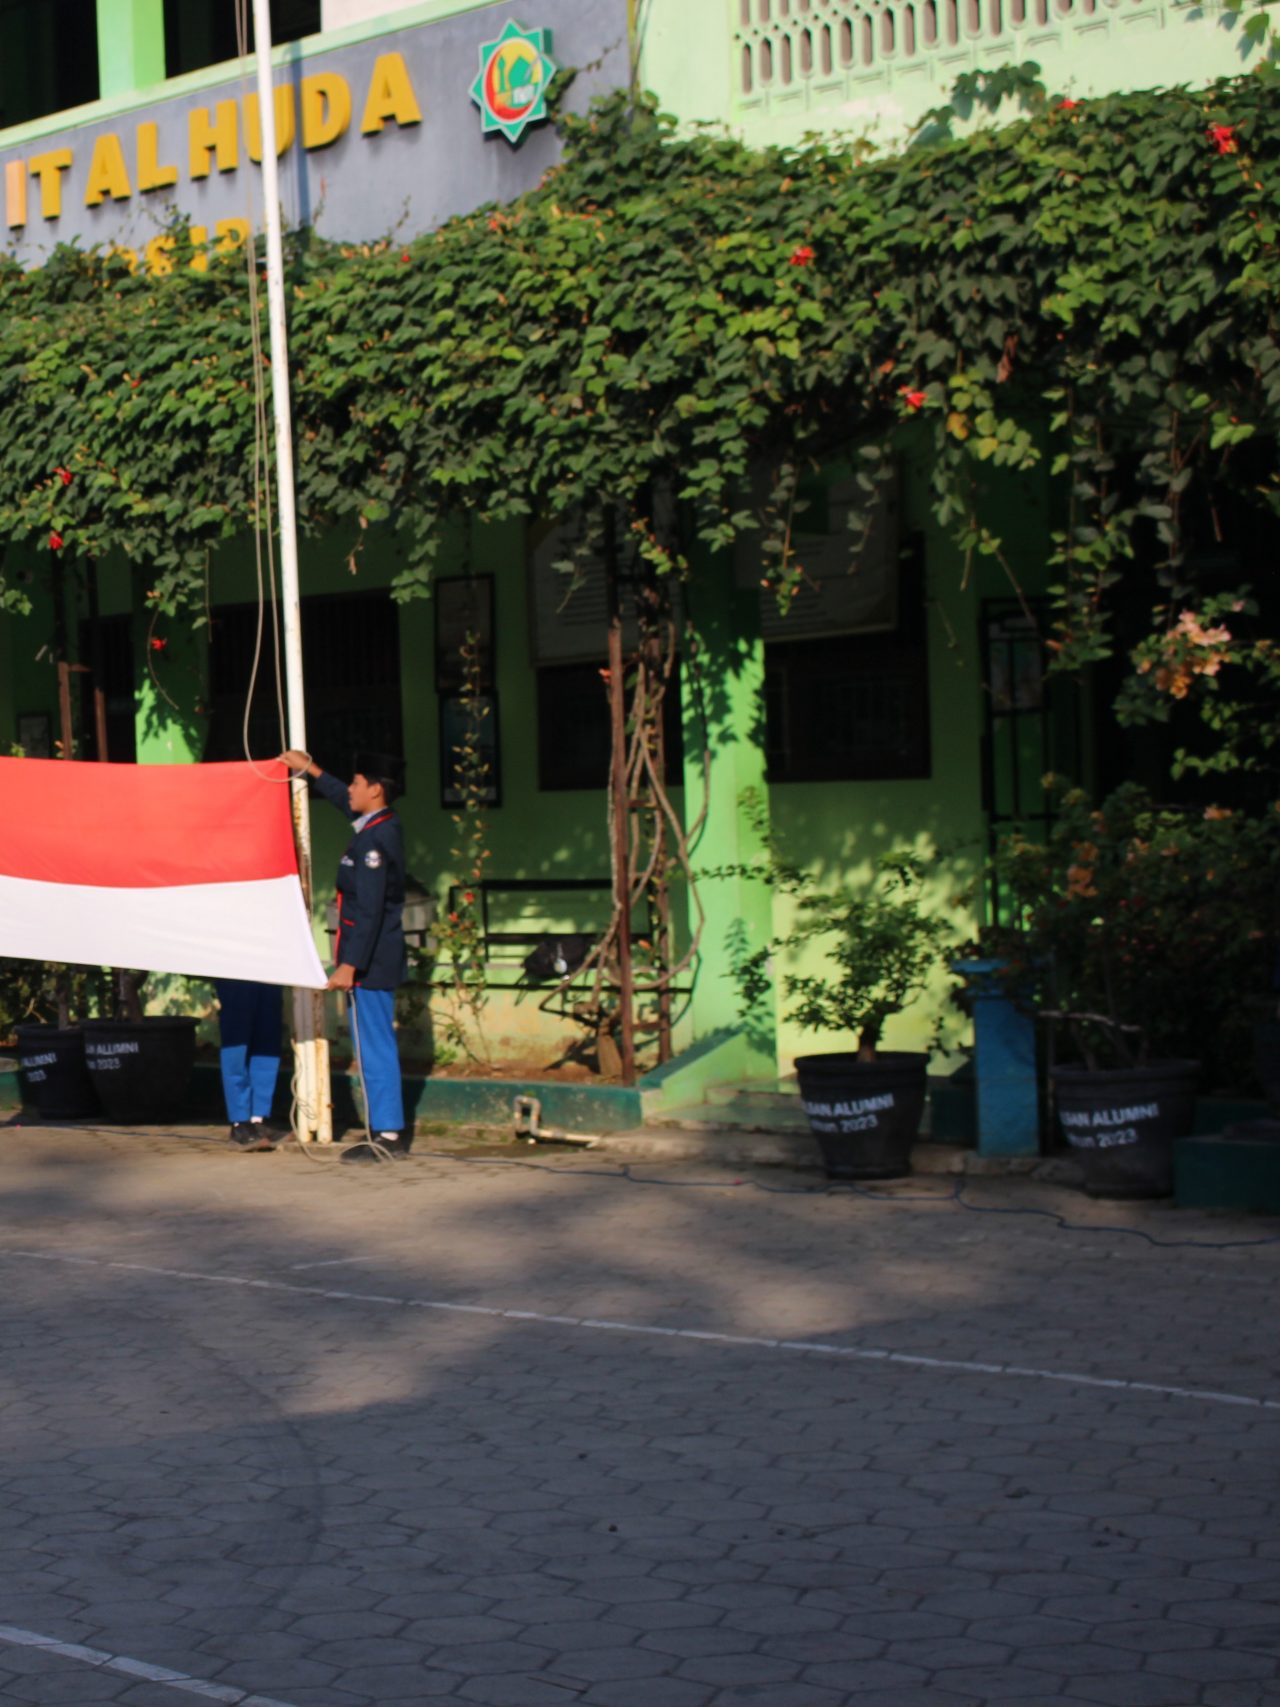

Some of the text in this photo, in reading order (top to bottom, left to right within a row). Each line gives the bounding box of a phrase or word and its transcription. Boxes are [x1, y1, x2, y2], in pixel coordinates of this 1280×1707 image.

[6, 147, 73, 229] IT
[85, 122, 178, 209] AL
[188, 53, 422, 180] HUDA
[96, 1041, 140, 1056] ALUMNI
[833, 1092, 895, 1117] ALUMNI
[1092, 1102, 1160, 1127] ALUMNI
[840, 1113, 879, 1134] 2023
[1096, 1127, 1138, 1148] 2023
